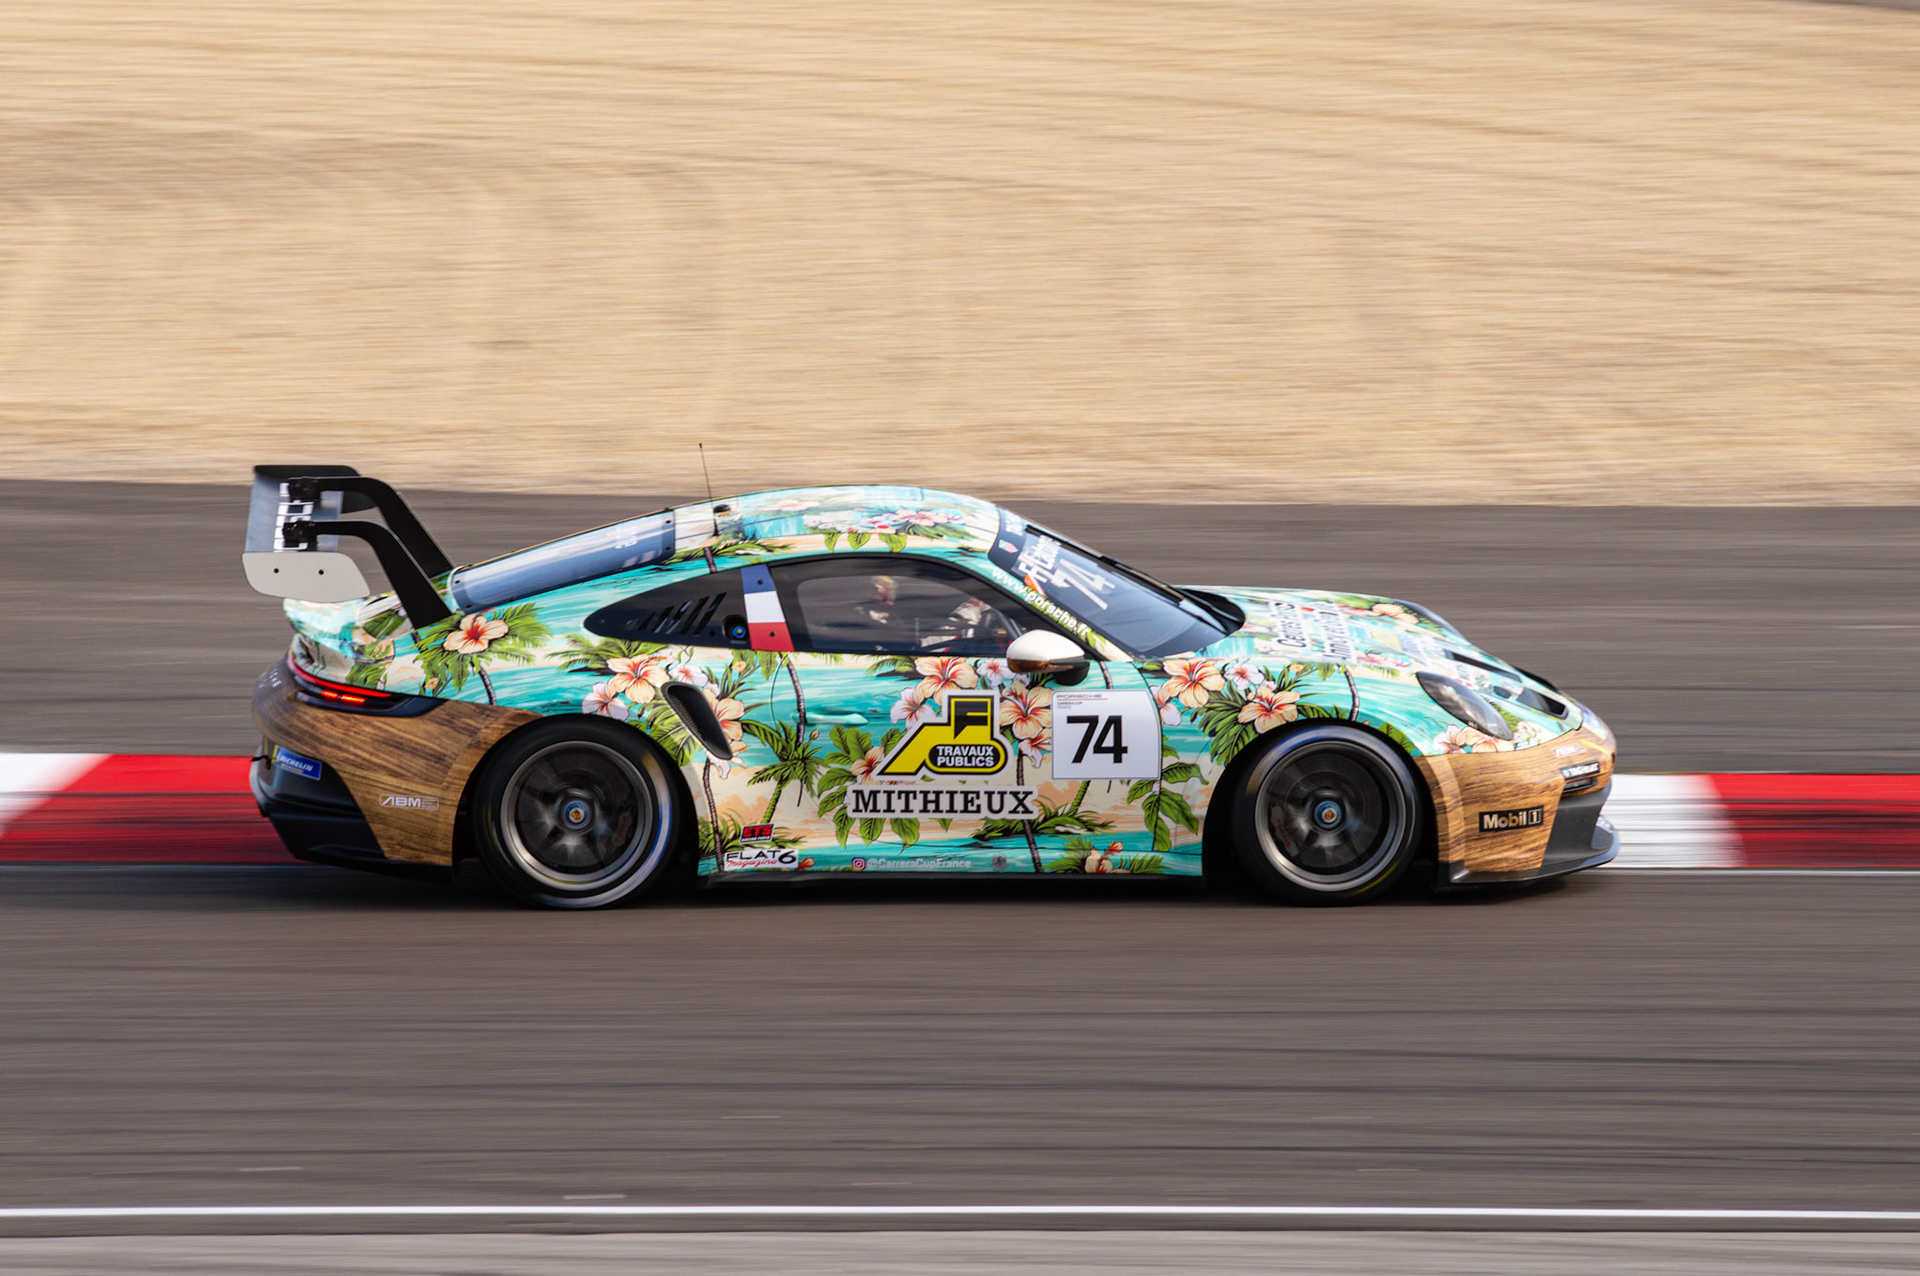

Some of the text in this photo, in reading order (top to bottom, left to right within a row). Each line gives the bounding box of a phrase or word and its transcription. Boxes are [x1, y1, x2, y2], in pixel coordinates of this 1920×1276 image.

[991, 566, 1090, 637] www.porsche.fr
[1066, 715, 1128, 763] 74
[936, 746, 994, 756] TRAVAUX
[936, 756, 994, 767] PUBLICS
[852, 789, 1034, 815] MITHIEUX
[1483, 810, 1527, 829] Mobil
[726, 849, 797, 864] FLAT 6
[867, 858, 972, 869] @CarreraCupFrance
